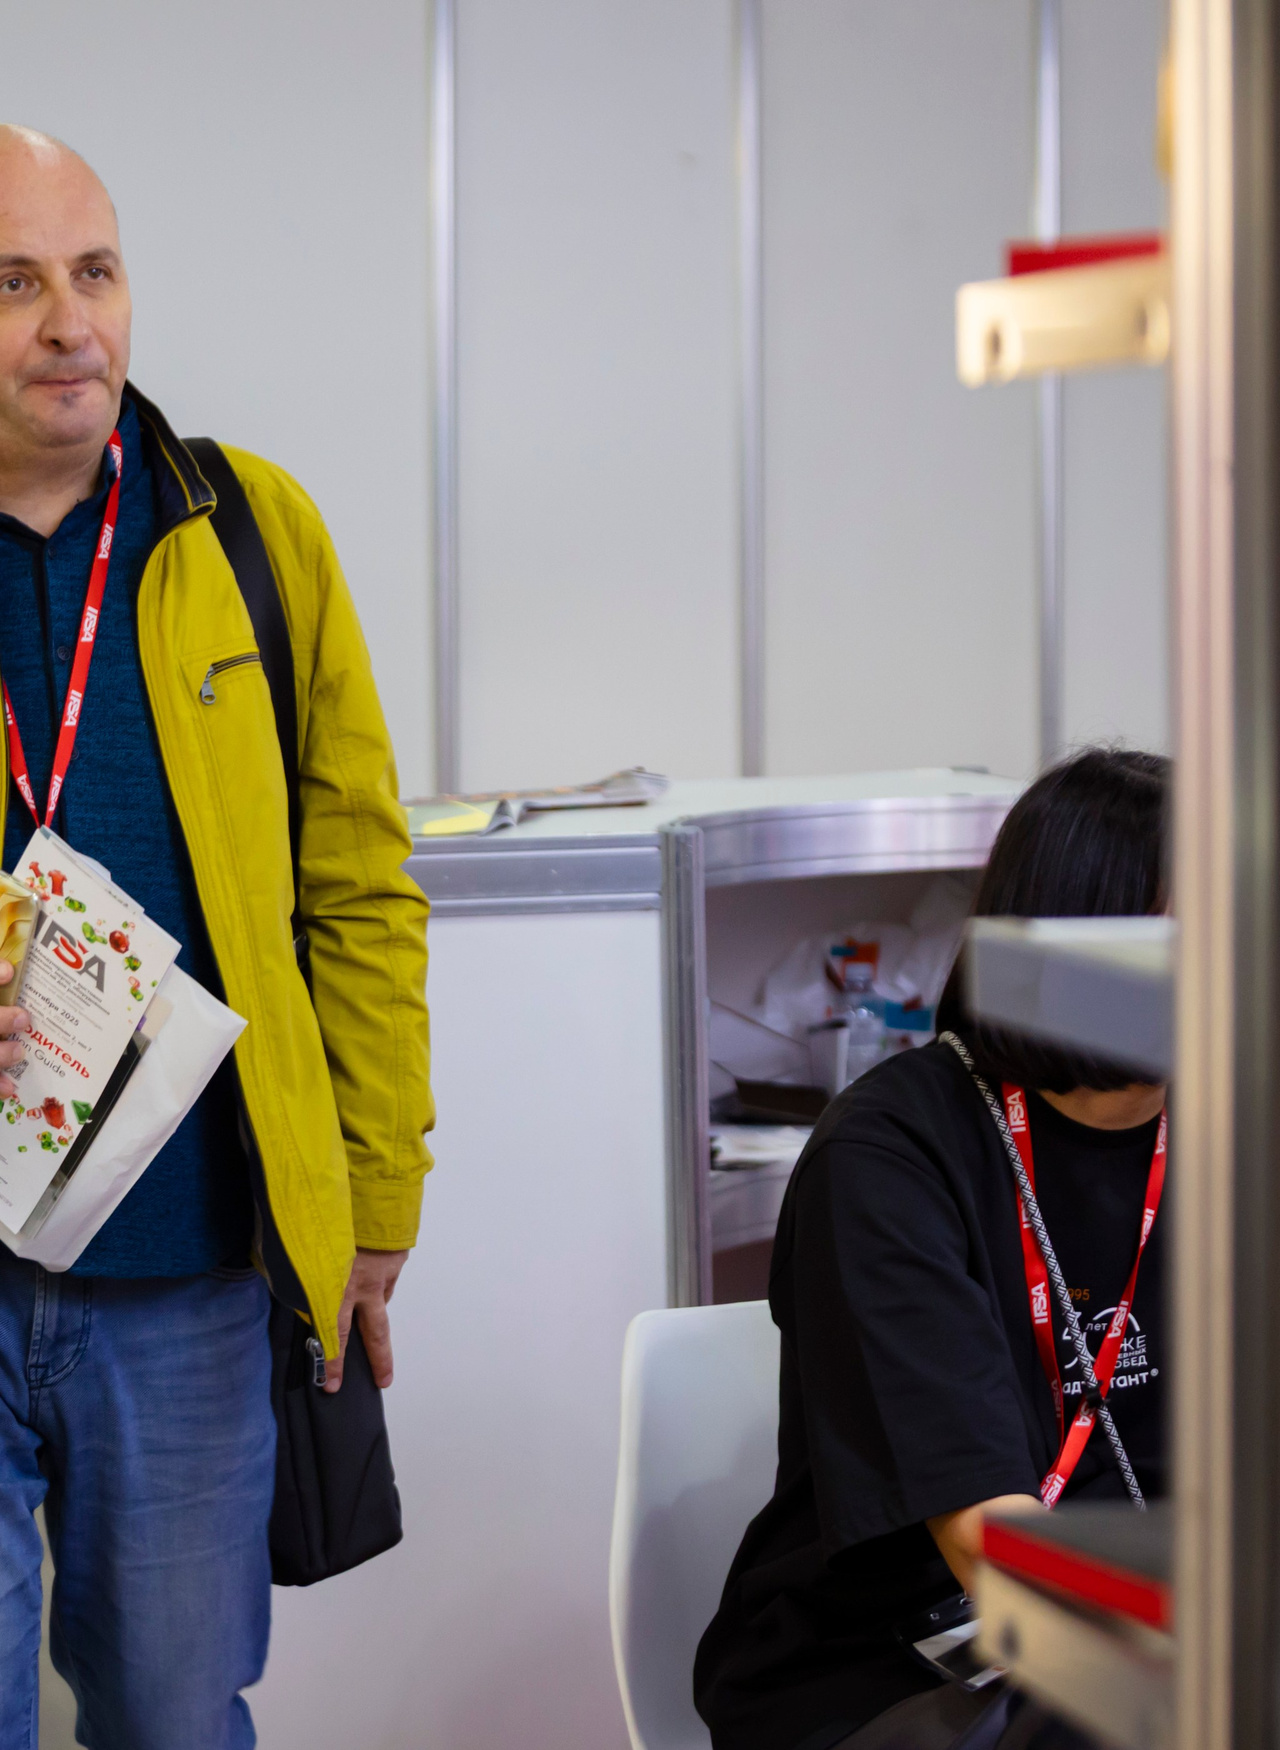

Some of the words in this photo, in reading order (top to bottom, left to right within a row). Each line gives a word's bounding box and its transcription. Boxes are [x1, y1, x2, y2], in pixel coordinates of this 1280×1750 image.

[24, 982, 60, 1012] сентября
[60, 1010, 80, 1027] 2025
[23, 1023, 91, 1079] одитель
[34, 1047, 67, 1078] Guide
[1067, 1288, 1090, 1301] 995
[1085, 1322, 1108, 1331] лет
[1120, 1334, 1147, 1352] ЖЕ
[1118, 1346, 1147, 1359] ЕВНЫХ
[1114, 1355, 1148, 1368] ОБЕД
